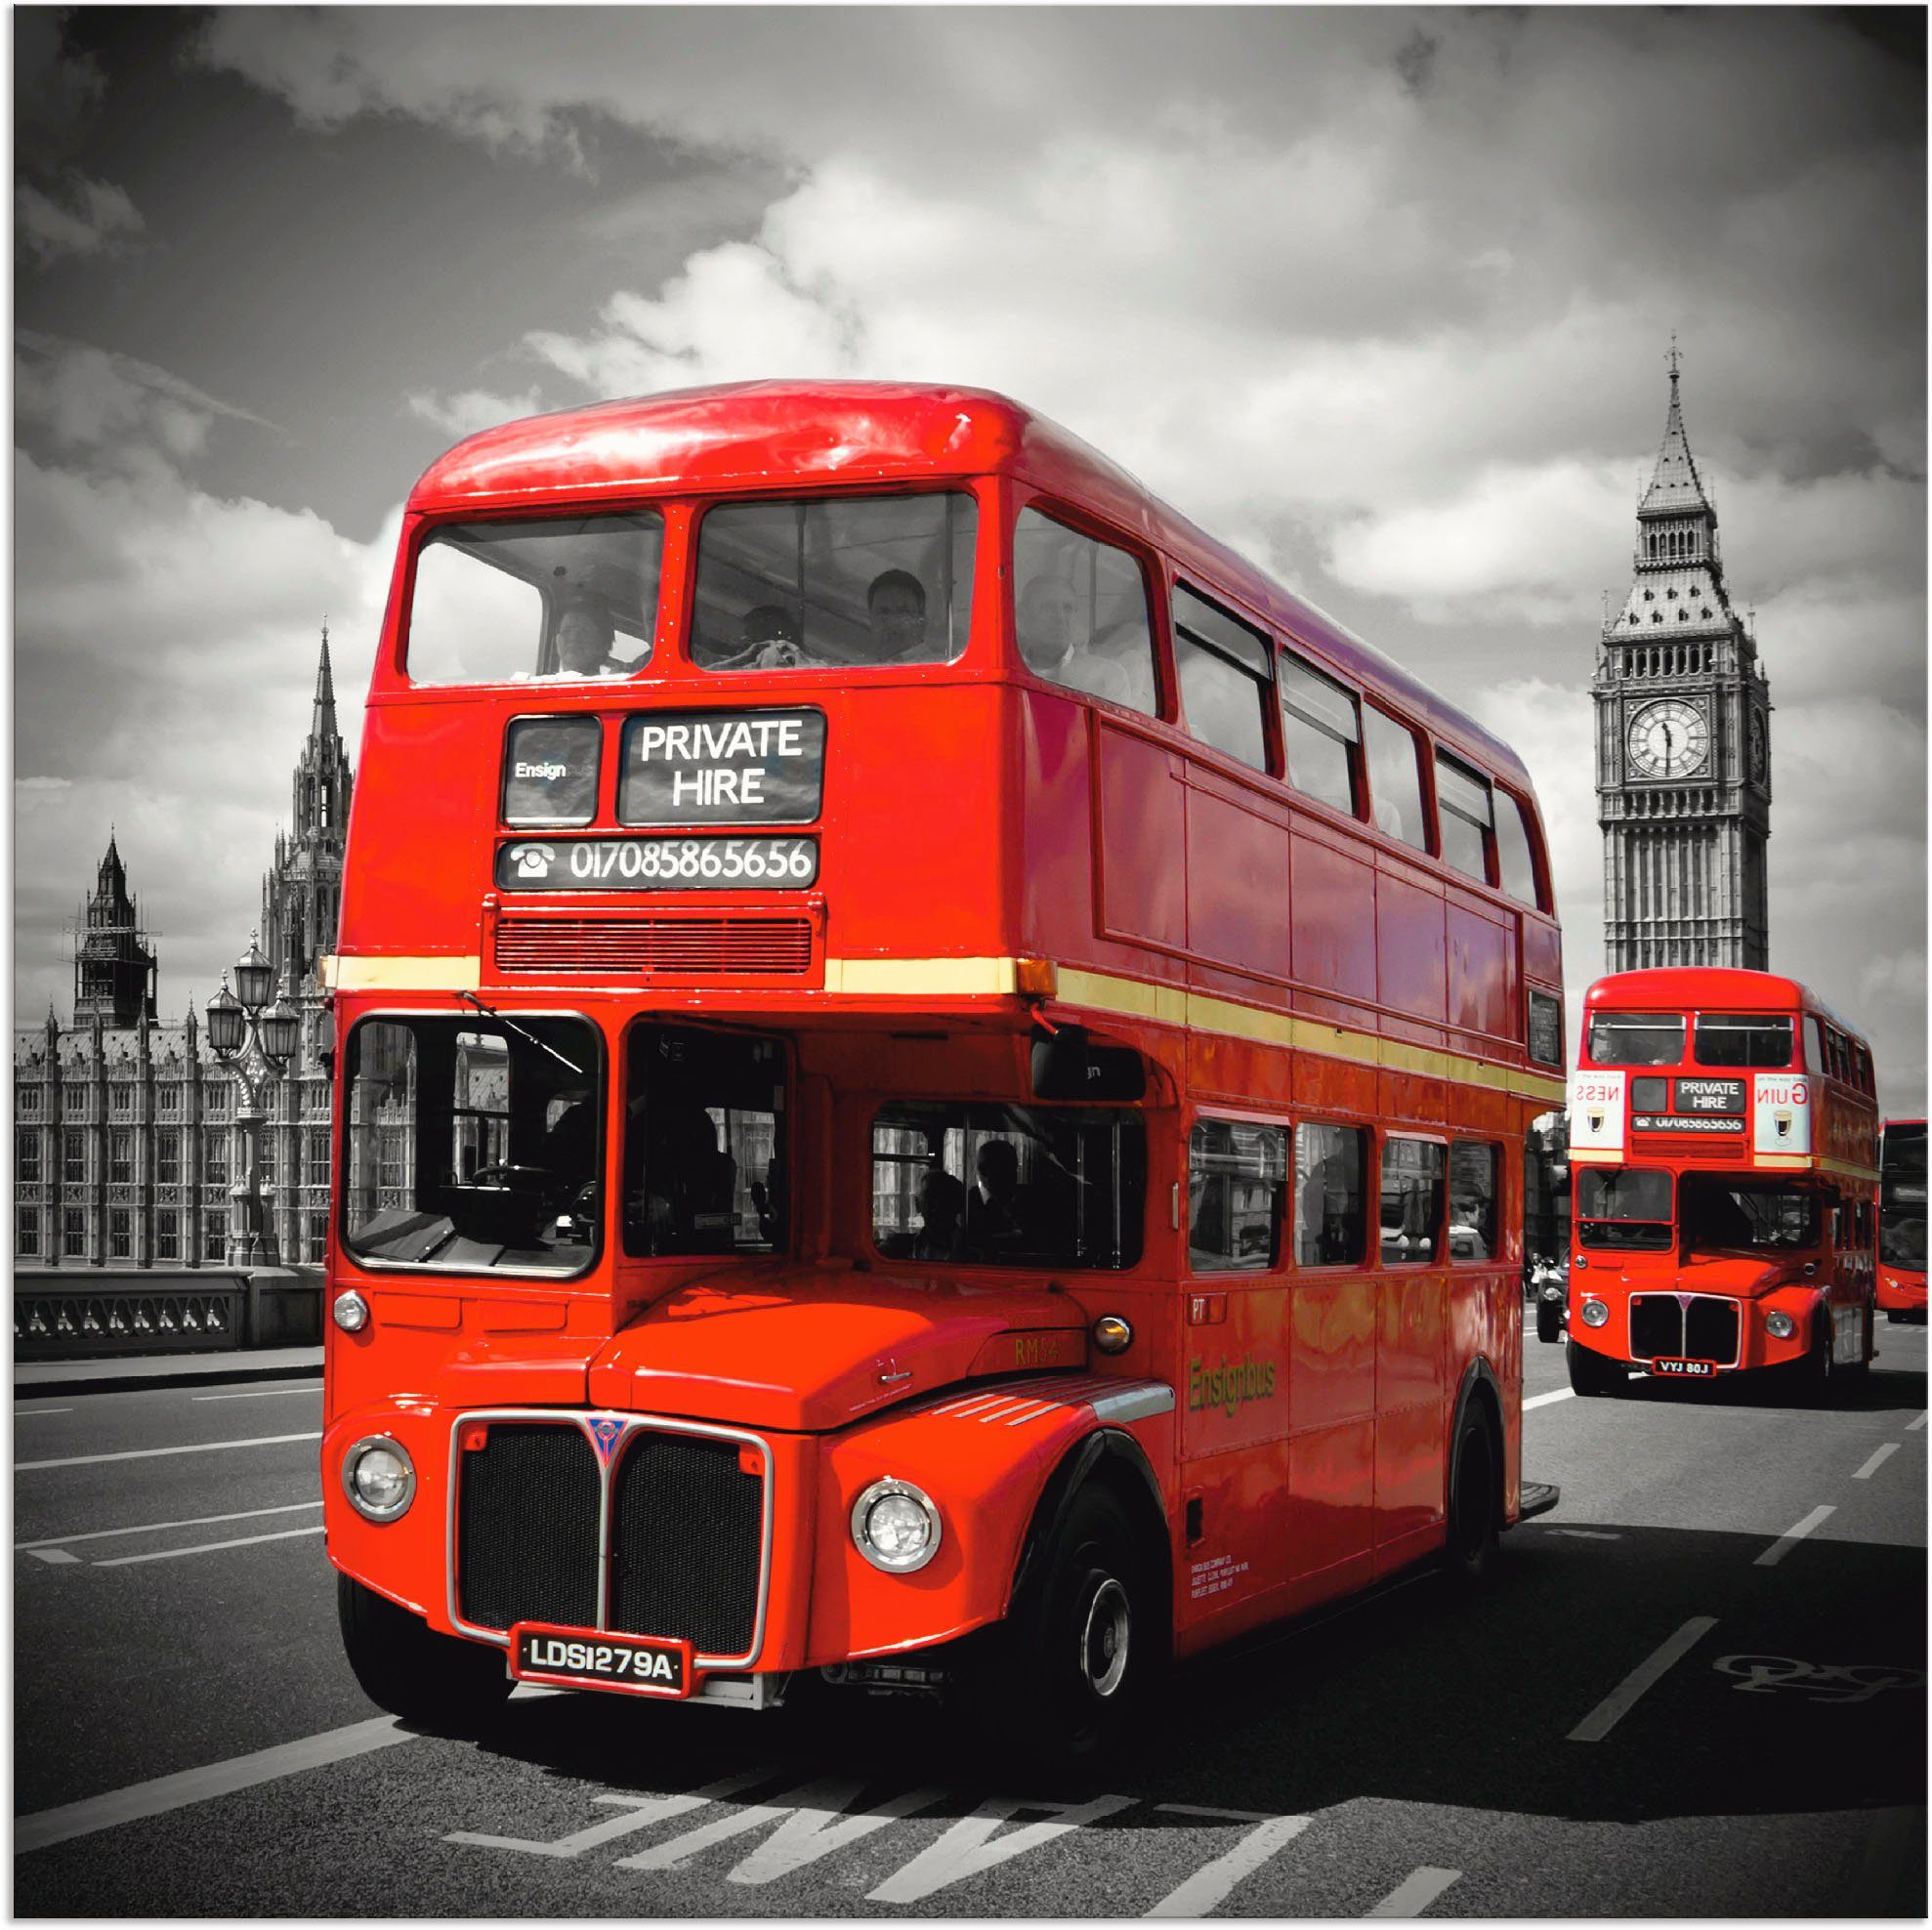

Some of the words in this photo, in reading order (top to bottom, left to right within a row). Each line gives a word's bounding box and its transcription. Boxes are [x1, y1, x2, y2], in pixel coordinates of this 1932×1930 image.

[641, 720, 803, 762] PRIVATE
[515, 762, 567, 780] Ensign
[672, 768, 766, 806] HIRE
[569, 841, 813, 879] 017085865656
[1681, 1082, 1740, 1095] PRIVATE
[1692, 1096, 1728, 1110] HIRE
[1193, 1298, 1205, 1320] PT
[1659, 1361, 1684, 1372] VYJ
[1686, 1363, 1708, 1374] 80J
[1190, 1353, 1275, 1418] Ensignbus
[530, 1639, 673, 1680] LDS1279A
